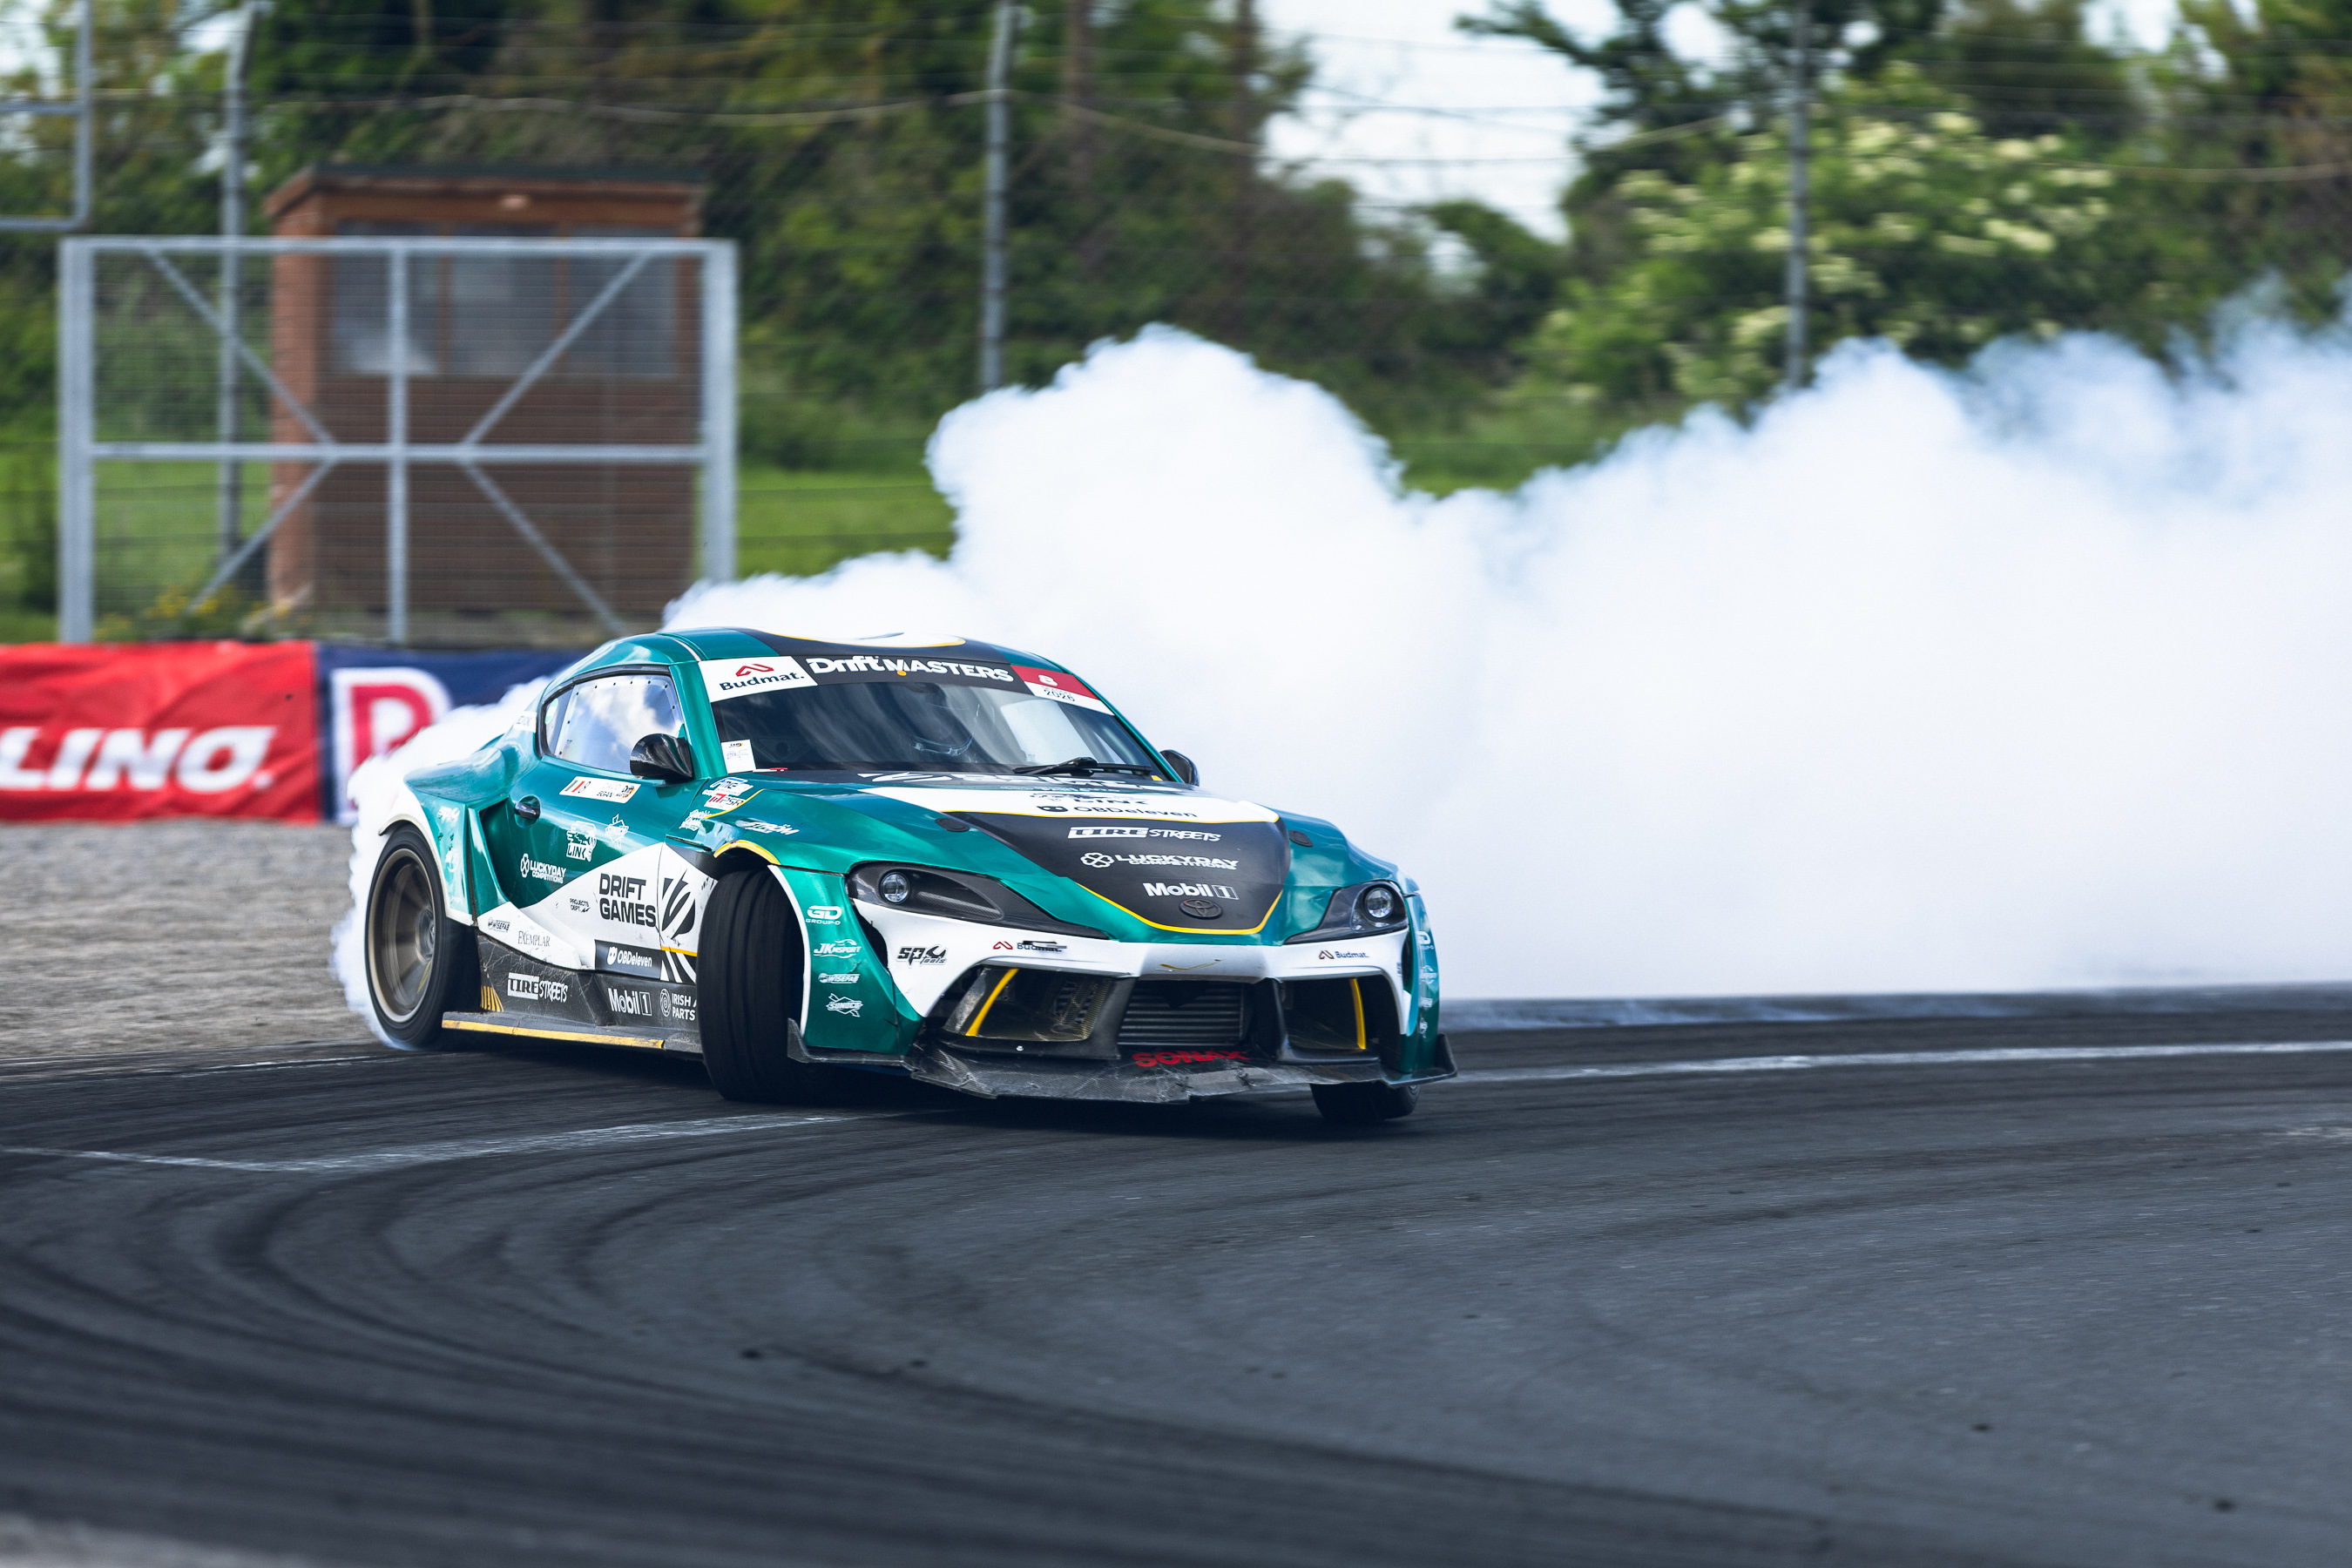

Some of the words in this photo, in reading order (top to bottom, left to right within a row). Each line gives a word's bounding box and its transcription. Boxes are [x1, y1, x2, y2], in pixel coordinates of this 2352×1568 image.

[883, 659, 1014, 683] MASTERS
[1073, 806, 1199, 818] OBDeleven
[1149, 828, 1221, 842] STREETS
[530, 860, 567, 878] LUCKYDAY
[1114, 855, 1240, 868] LUCKYDAY
[1128, 859, 1237, 870] COMPETITIONS
[531, 871, 564, 884] COMPETITIONS
[599, 873, 646, 901] DRIFT
[1143, 882, 1214, 897] Mobil
[598, 899, 657, 928] GAMES
[517, 930, 551, 948] EXEMPLAR
[617, 949, 653, 968] OBDeleven
[508, 975, 539, 998] TIRE
[538, 980, 569, 1003] STREETS
[607, 988, 640, 1016] Mobil
[672, 993, 692, 1007] IRISH
[672, 1006, 696, 1021] PARTS
[1132, 1051, 1251, 1067] SONAX
